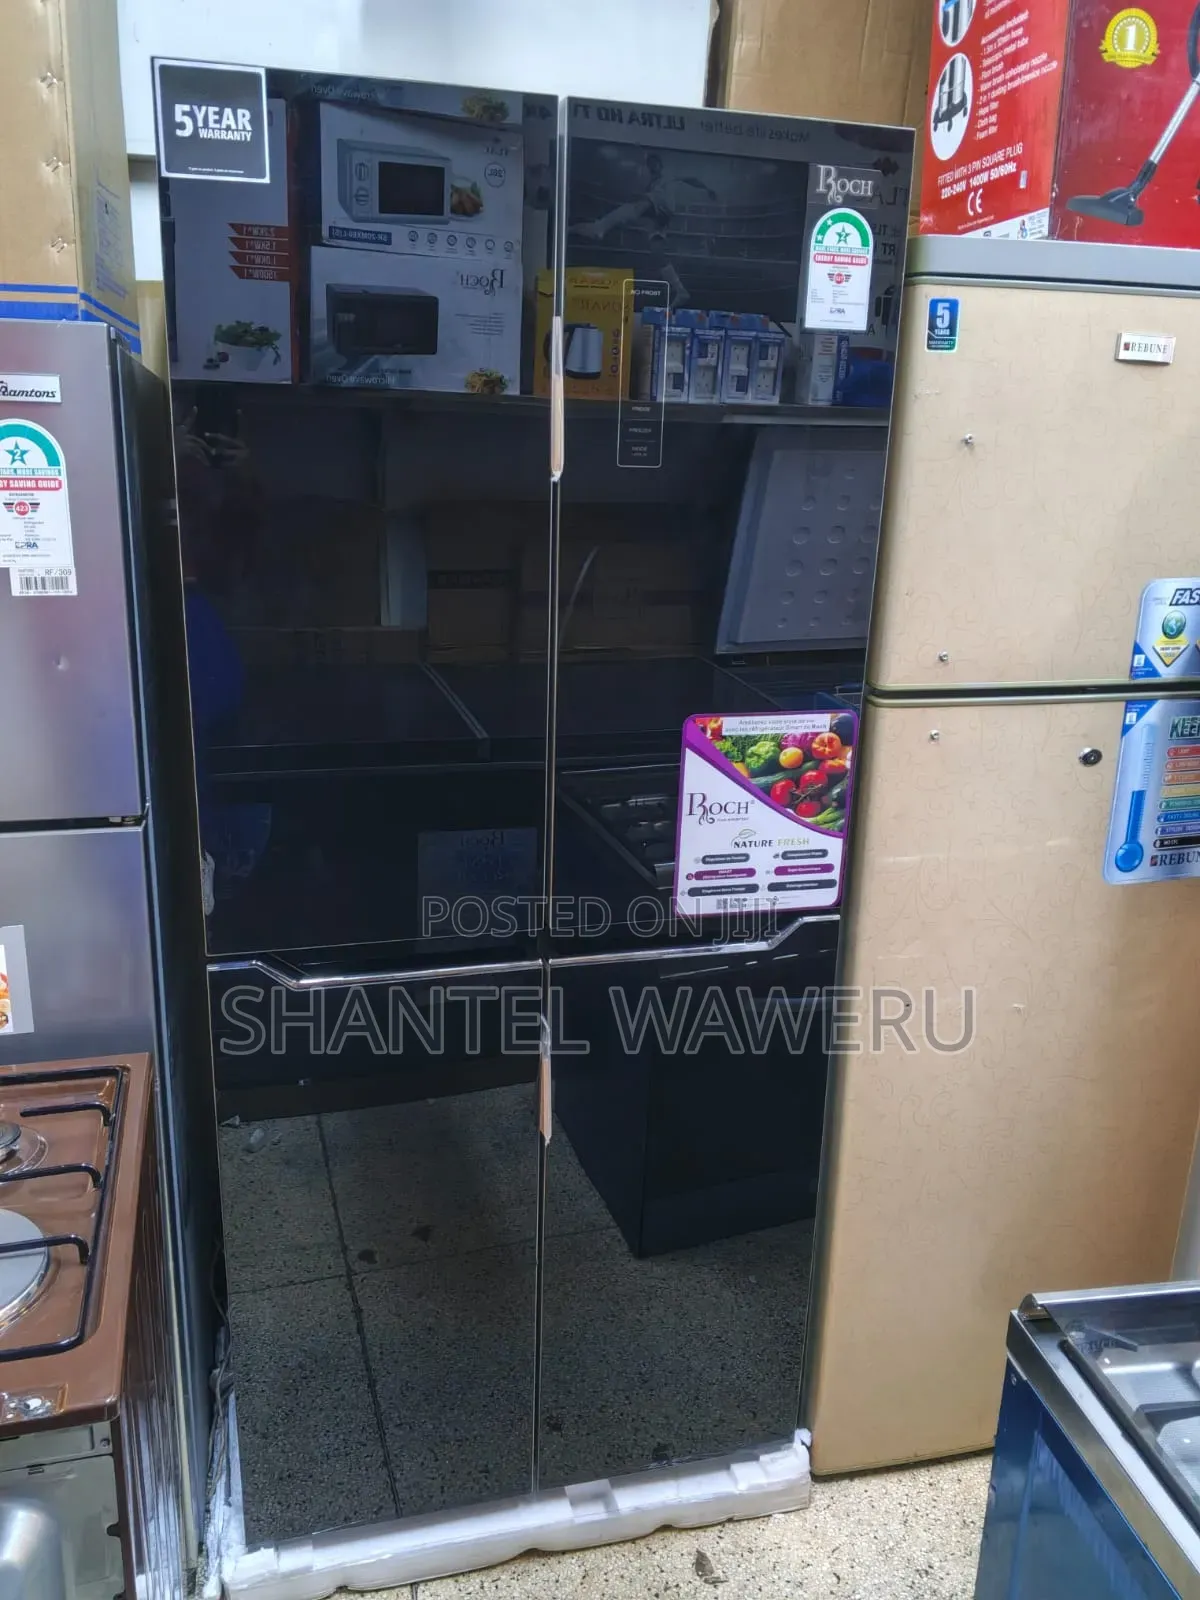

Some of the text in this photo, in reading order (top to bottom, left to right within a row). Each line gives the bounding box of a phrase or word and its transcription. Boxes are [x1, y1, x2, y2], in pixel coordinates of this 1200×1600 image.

[1124, 24, 1136, 50] 1
[175, 103, 194, 137] 5
[192, 105, 253, 131] YEAR
[199, 128, 252, 142] WARRANTY
[972, 160, 981, 172] PIN
[981, 149, 1005, 169] SQUARE
[1005, 142, 1023, 159] PLUG
[967, 188, 983, 217] CE
[936, 302, 950, 329] 5
[1130, 342, 1168, 354] REBUNE
[15, 450, 21, 460] 2
[10, 479, 36, 489] SAVING
[38, 479, 60, 489] GUIDE
[45, 568, 72, 576] RF/309
[733, 837, 810, 849] NATURE FRESH
